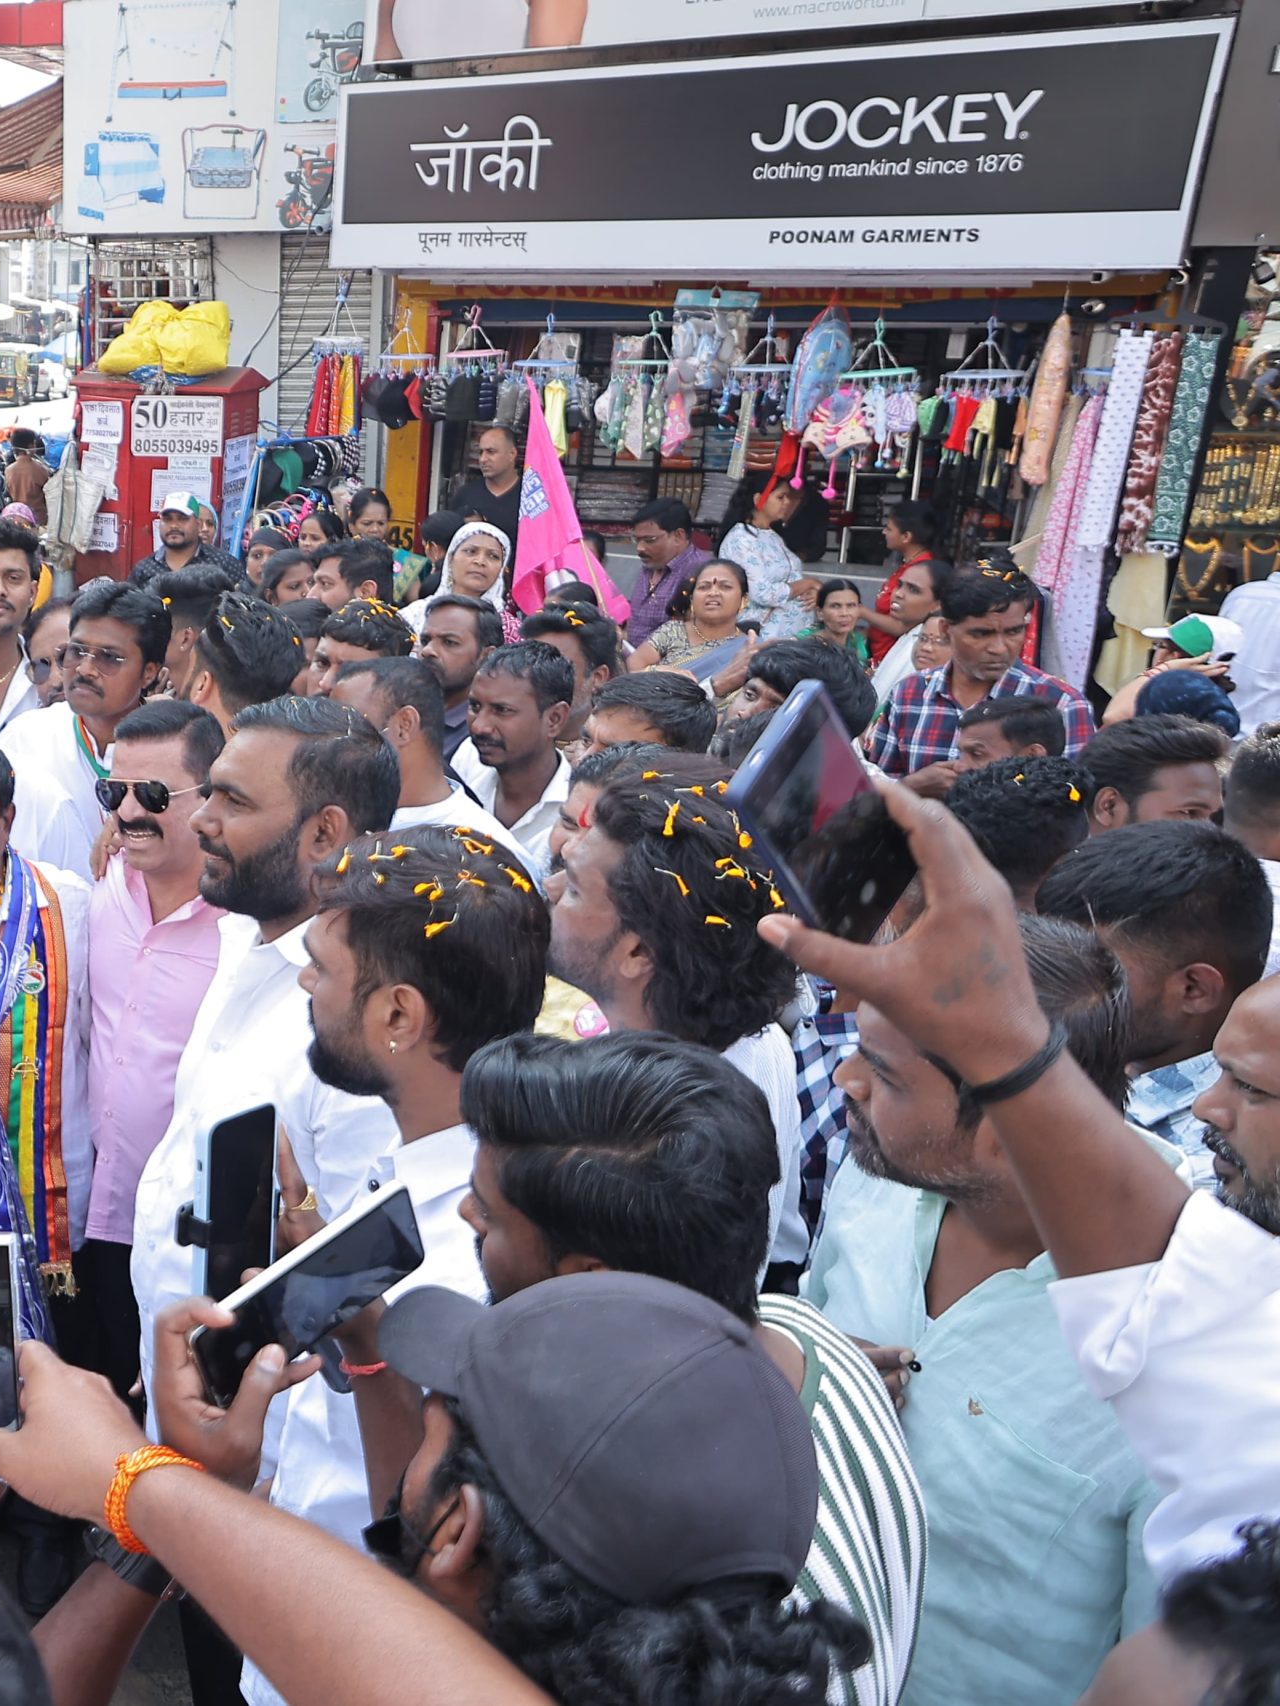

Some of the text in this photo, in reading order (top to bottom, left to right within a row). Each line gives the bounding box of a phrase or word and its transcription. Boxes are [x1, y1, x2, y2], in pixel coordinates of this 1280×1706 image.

[751, 89, 1045, 152] JOCKEY
[409, 114, 553, 193] जॉकी
[752, 153, 1024, 182] clothing mankind since 1876
[418, 231, 452, 253] पूनम
[768, 227, 980, 244] POONAM GARMENTS
[135, 400, 167, 429] 50
[169, 411, 205, 427] हजार
[134, 439, 218, 453] 8055039495
